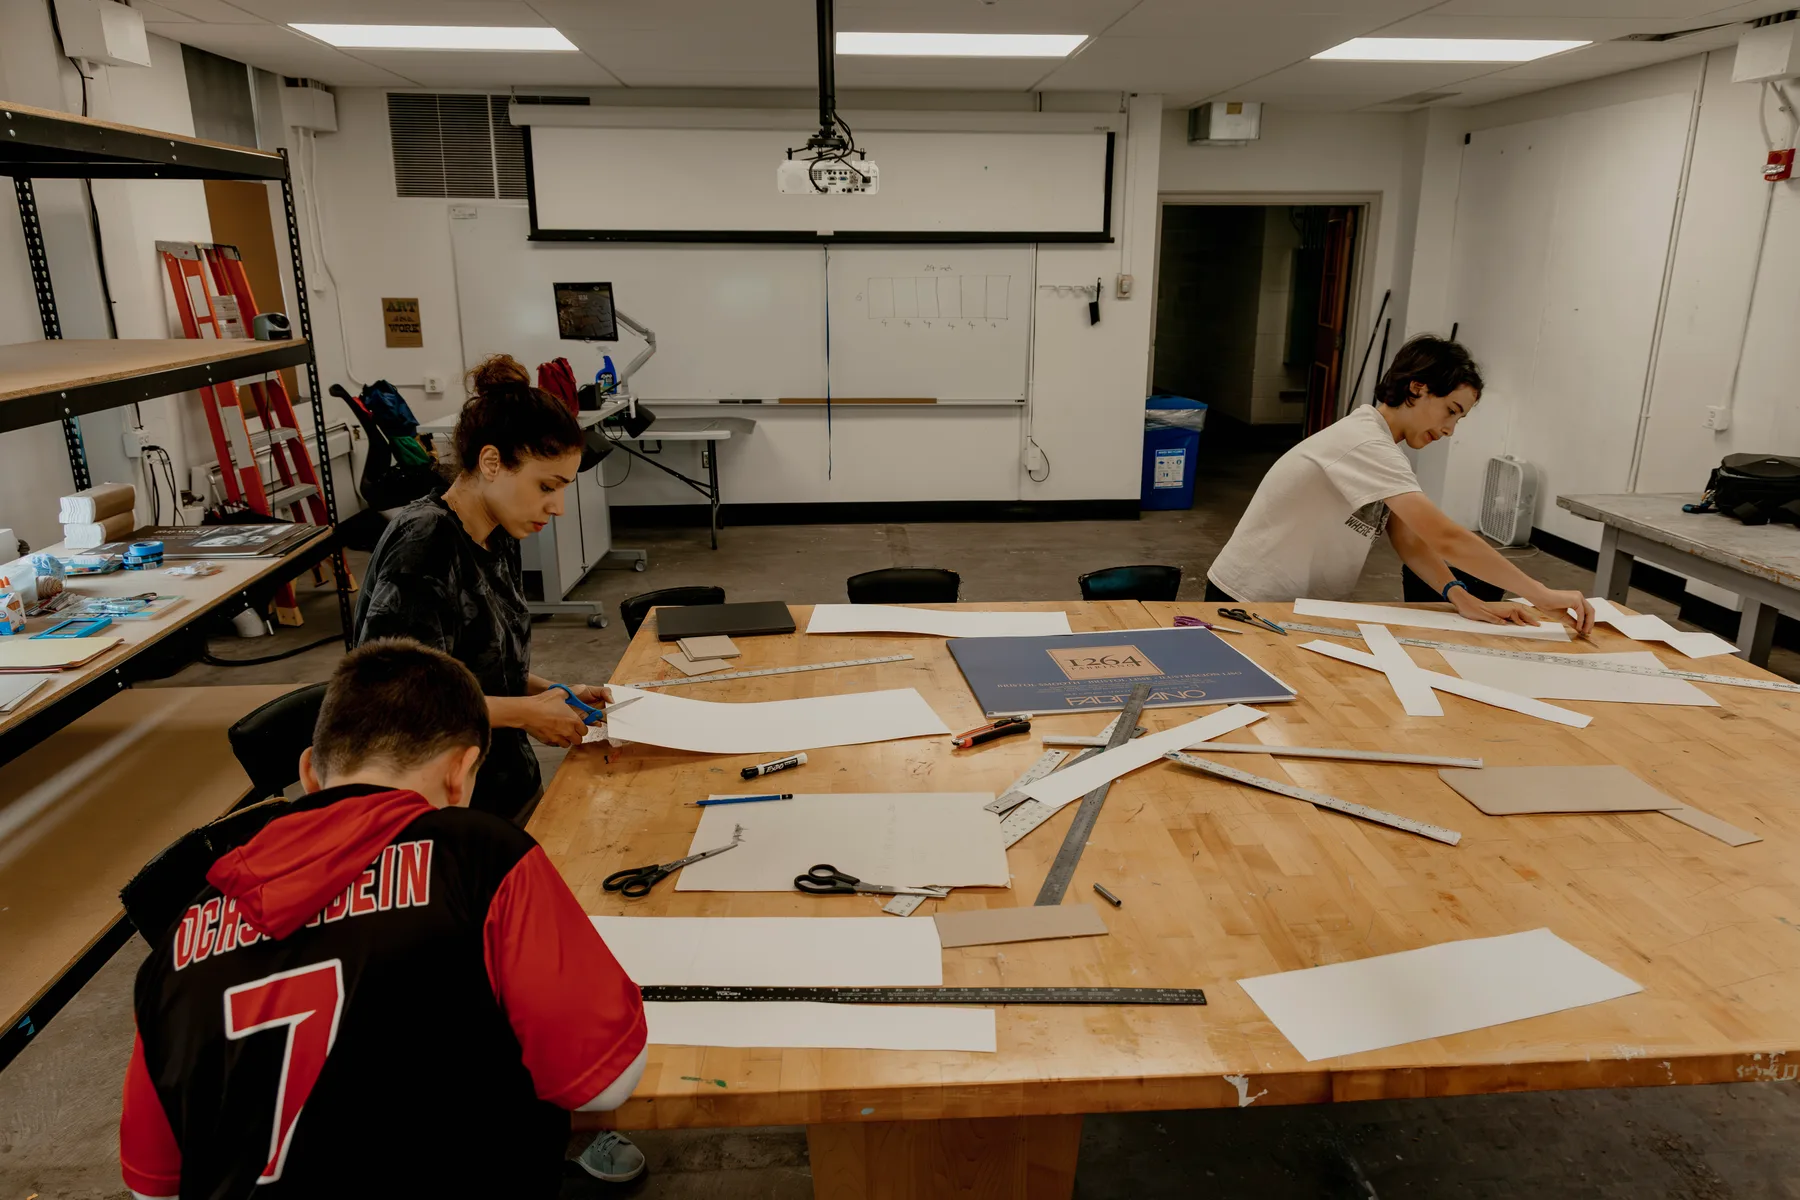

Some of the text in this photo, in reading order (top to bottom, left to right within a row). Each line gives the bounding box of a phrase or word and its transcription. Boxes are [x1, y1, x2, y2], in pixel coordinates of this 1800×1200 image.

[386, 300, 416, 312] ART
[388, 324, 420, 333] WORK
[1344, 516, 1373, 537] WHERE
[1067, 654, 1142, 667] 1264
[1066, 689, 1206, 706] FABANO
[766, 763, 784, 773] EXPO
[174, 839, 433, 971] OCHEIN
[223, 958, 345, 1184] 7
